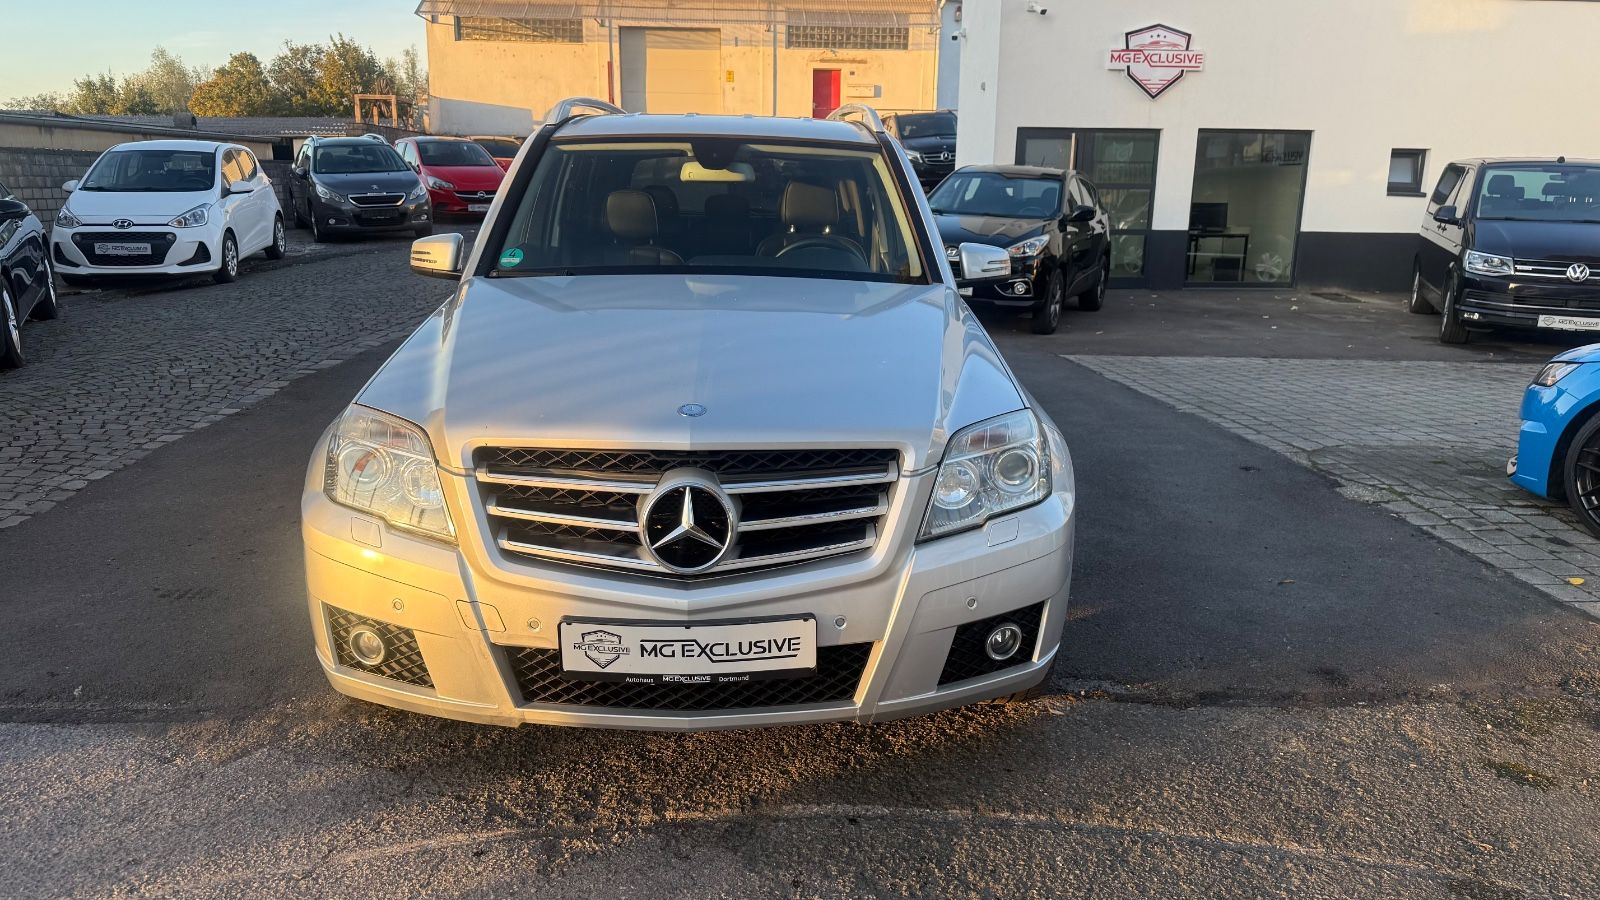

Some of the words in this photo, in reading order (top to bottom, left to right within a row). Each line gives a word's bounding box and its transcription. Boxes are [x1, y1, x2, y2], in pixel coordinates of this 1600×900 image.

[509, 249, 516, 258] 4
[640, 640, 675, 658] MG
[682, 637, 801, 661] EXCLUSIVE
